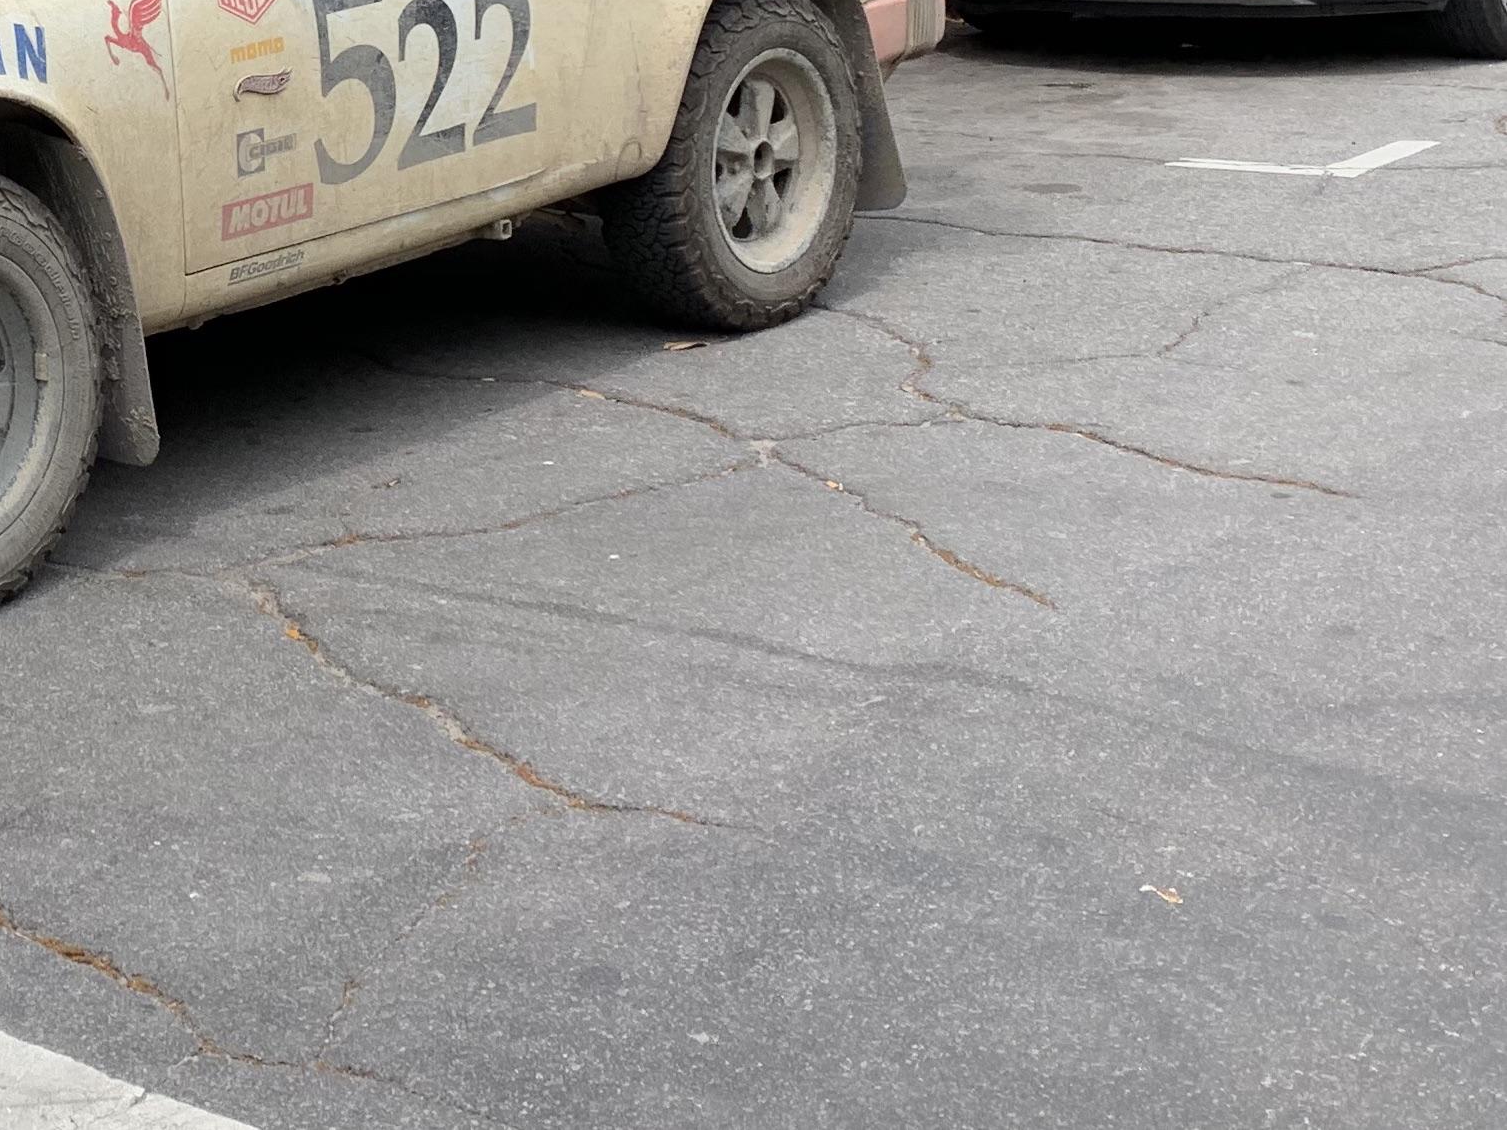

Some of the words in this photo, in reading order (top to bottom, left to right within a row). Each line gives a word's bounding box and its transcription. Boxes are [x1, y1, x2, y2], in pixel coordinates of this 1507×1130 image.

[229, 37, 285, 64] momo
[228, 188, 308, 235] MOTUL
[229, 248, 306, 282] BFGoodrich
